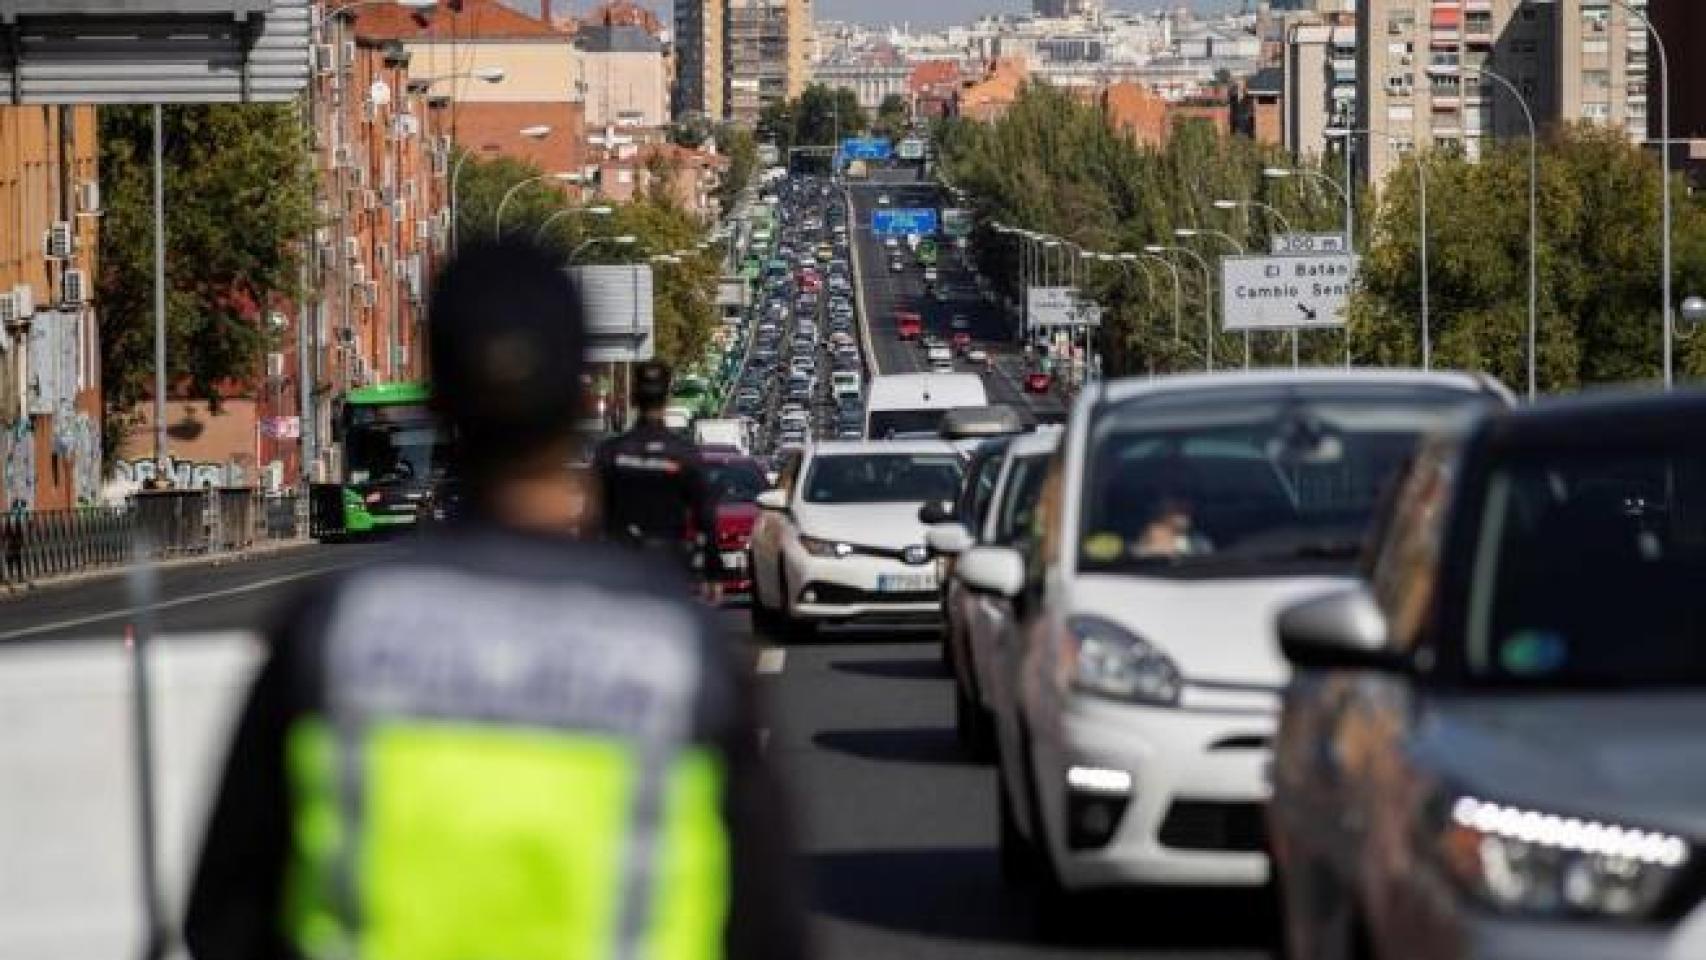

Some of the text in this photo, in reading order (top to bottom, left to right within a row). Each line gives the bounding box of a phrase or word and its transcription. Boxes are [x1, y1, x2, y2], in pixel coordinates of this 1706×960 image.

[1321, 238, 1338, 250] m
[1265, 265, 1280, 278] El
[1235, 285, 1299, 299] Cambio
